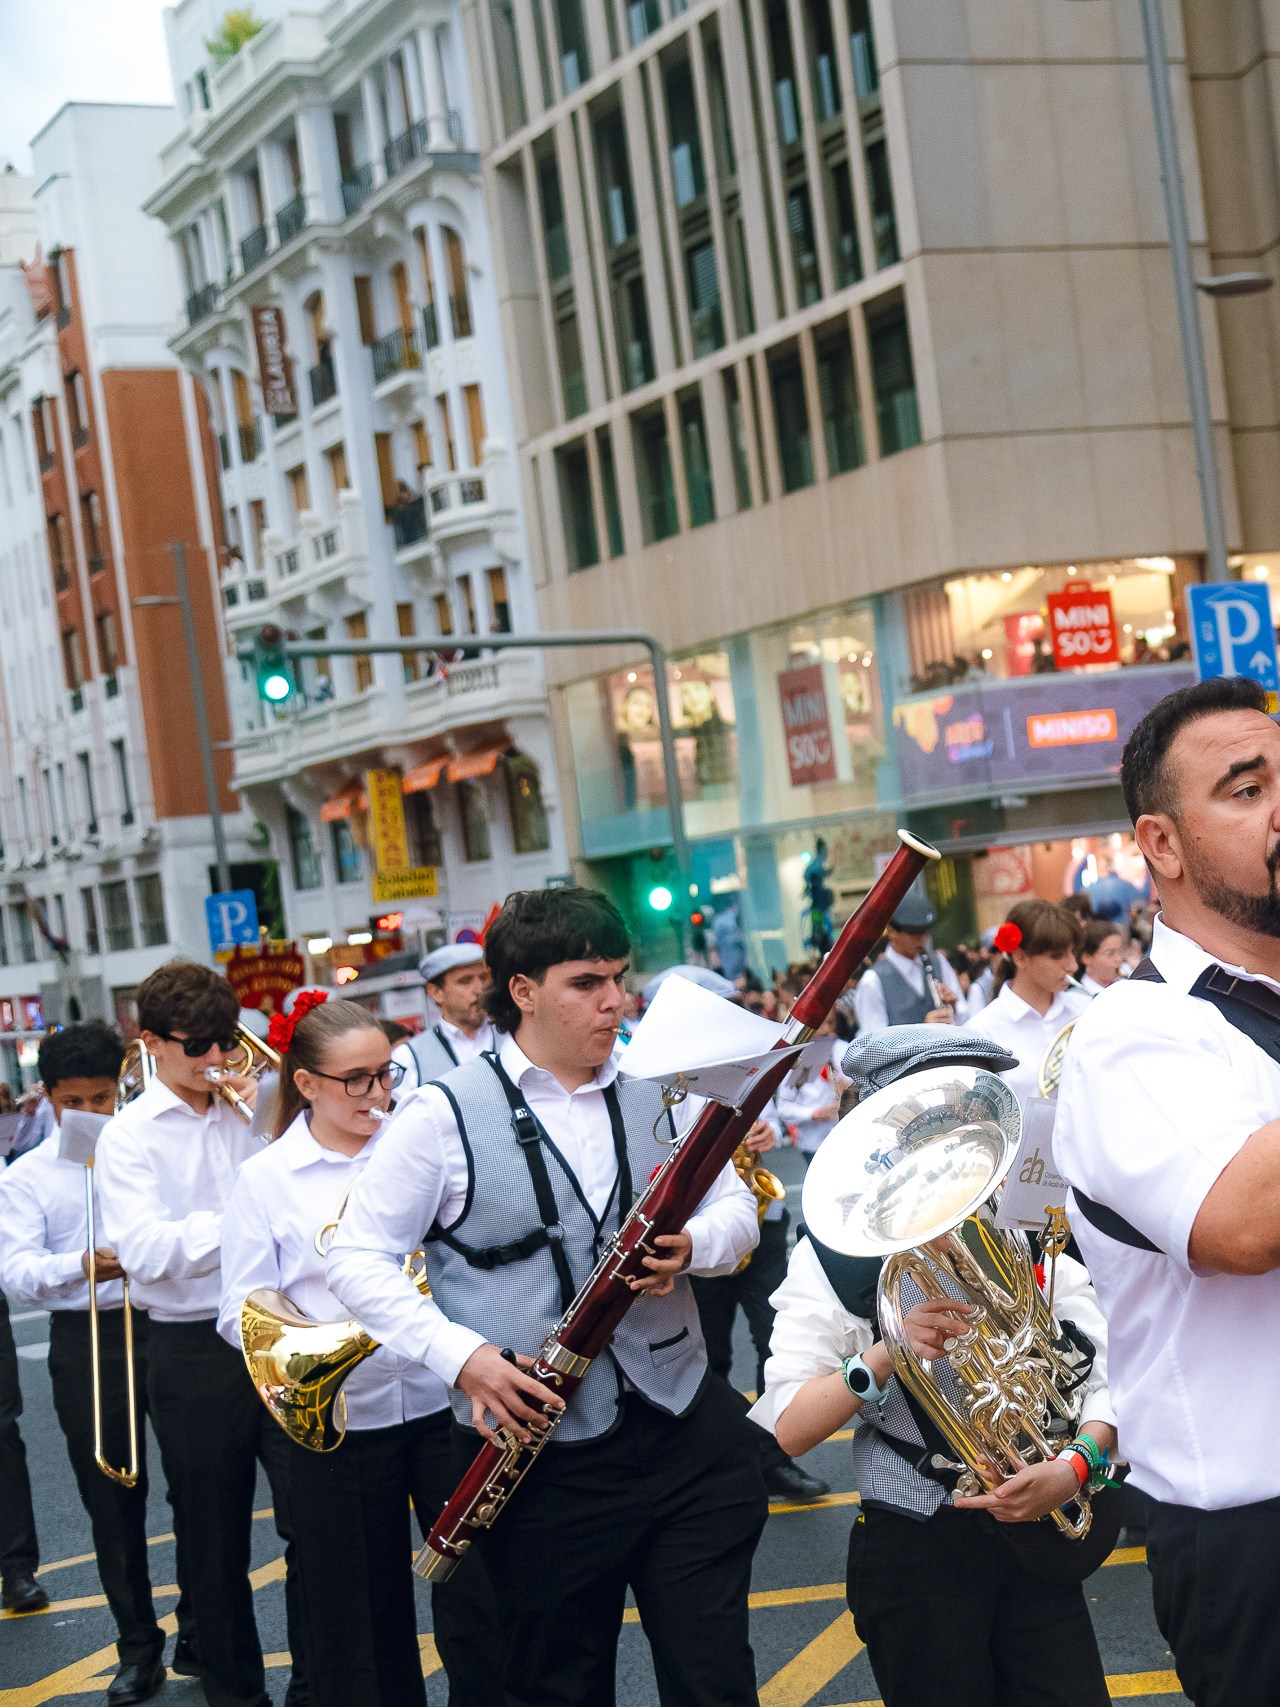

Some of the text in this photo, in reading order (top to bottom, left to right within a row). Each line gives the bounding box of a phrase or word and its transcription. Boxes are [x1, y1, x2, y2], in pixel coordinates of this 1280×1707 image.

[1054, 604, 1110, 630] MINI
[1205, 600, 1260, 678] P
[783, 691, 827, 724] MINI
[1033, 714, 1112, 742] MINISO
[218, 901, 247, 944] P
